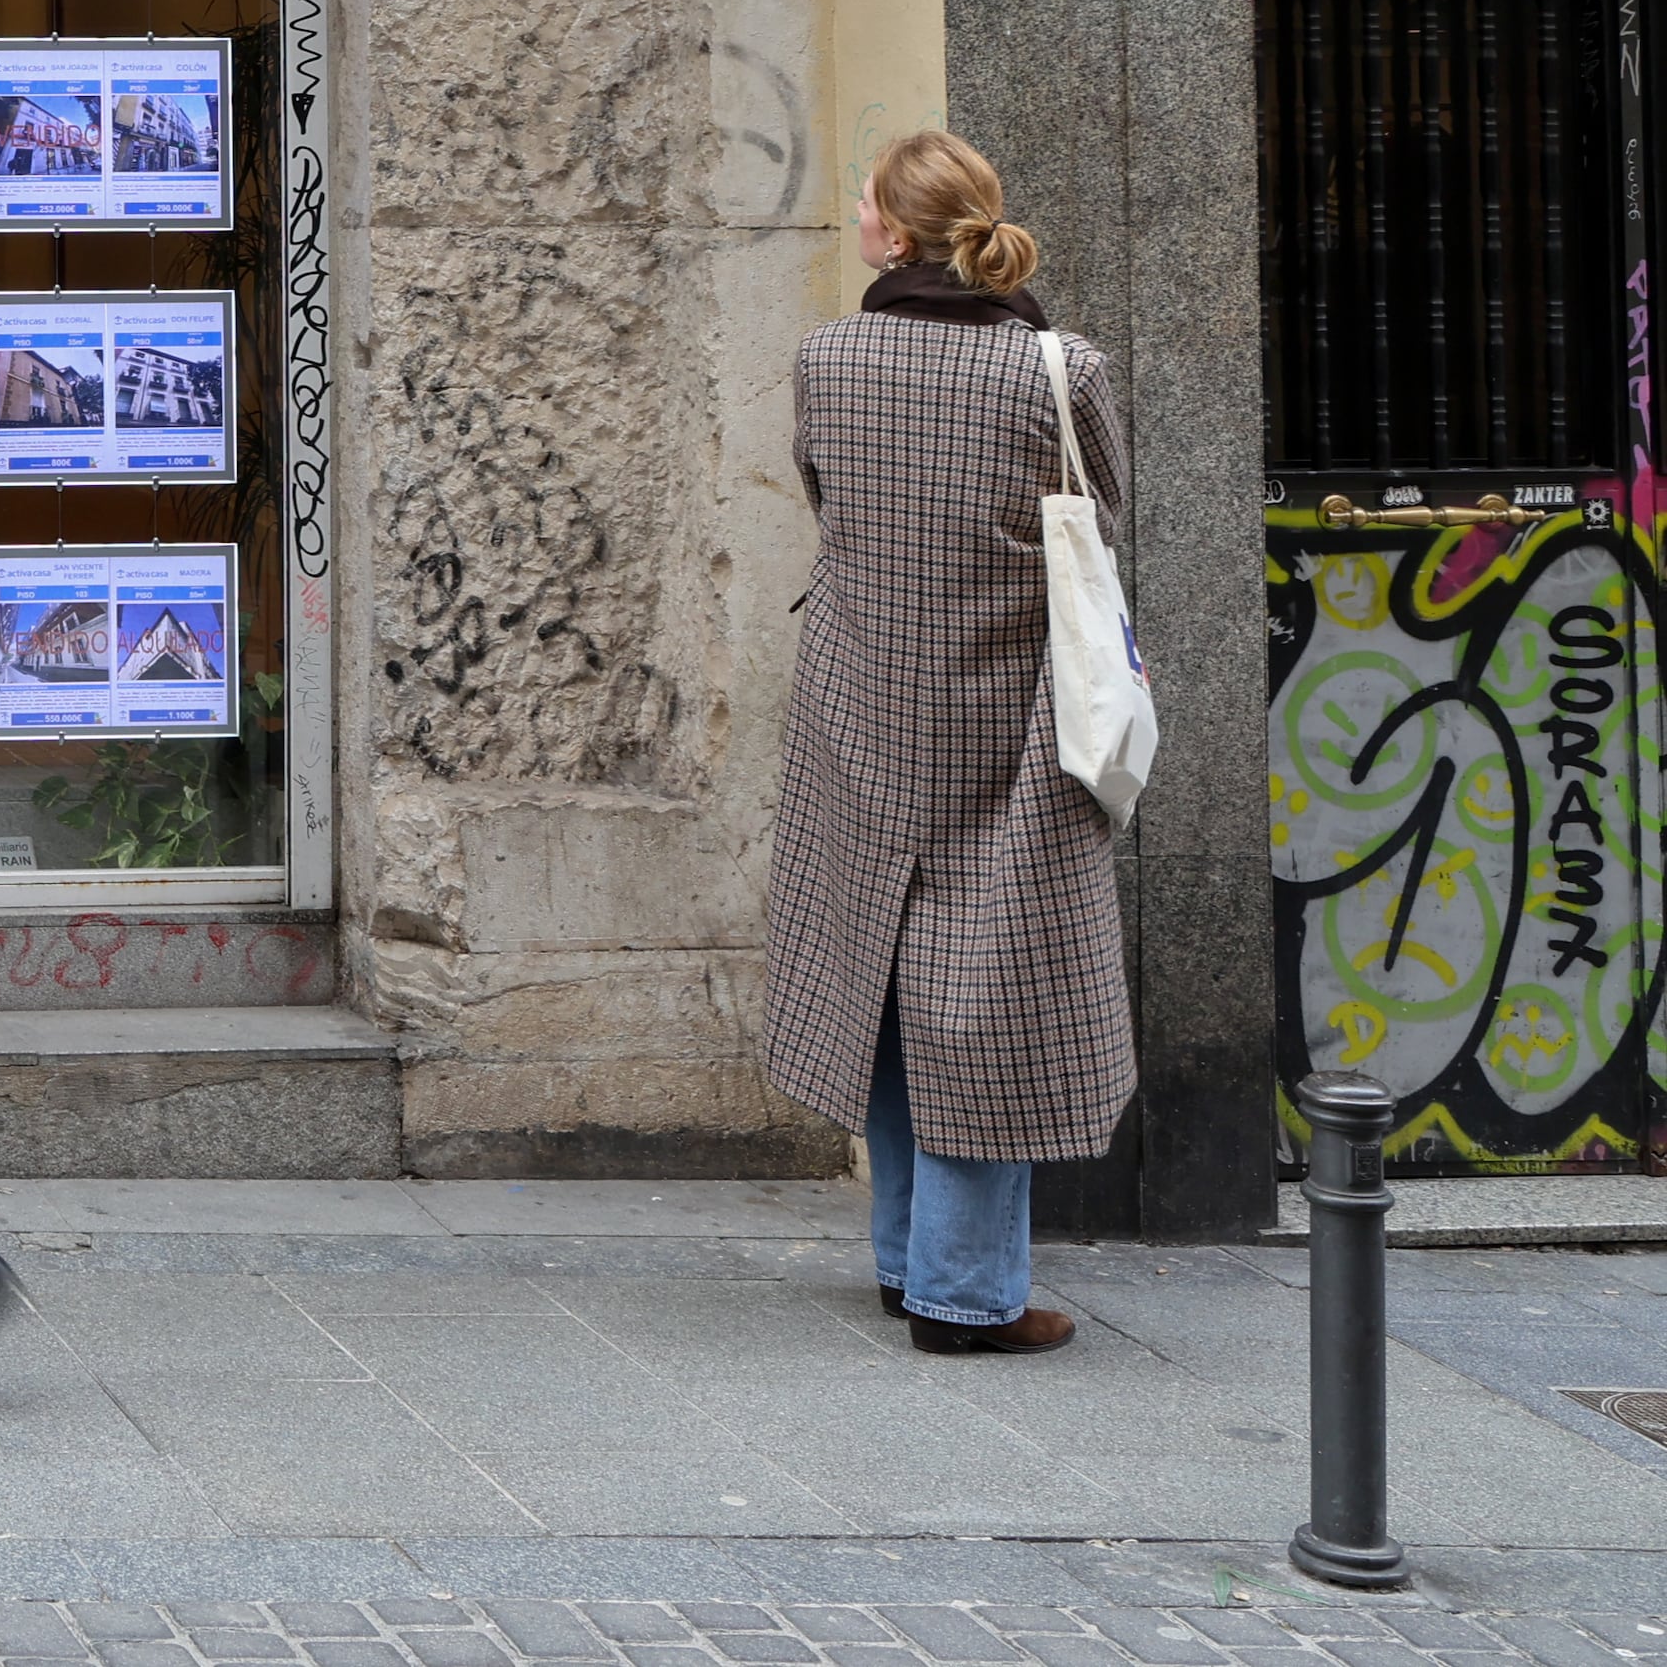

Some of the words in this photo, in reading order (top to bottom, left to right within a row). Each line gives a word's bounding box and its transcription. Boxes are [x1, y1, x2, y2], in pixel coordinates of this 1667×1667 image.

[1513, 484, 1575, 505] ZAKTER
[0, 630, 108, 655] VENDIDO
[117, 630, 225, 655] ALQUILADO
[1, 856, 32, 866] RAIN
